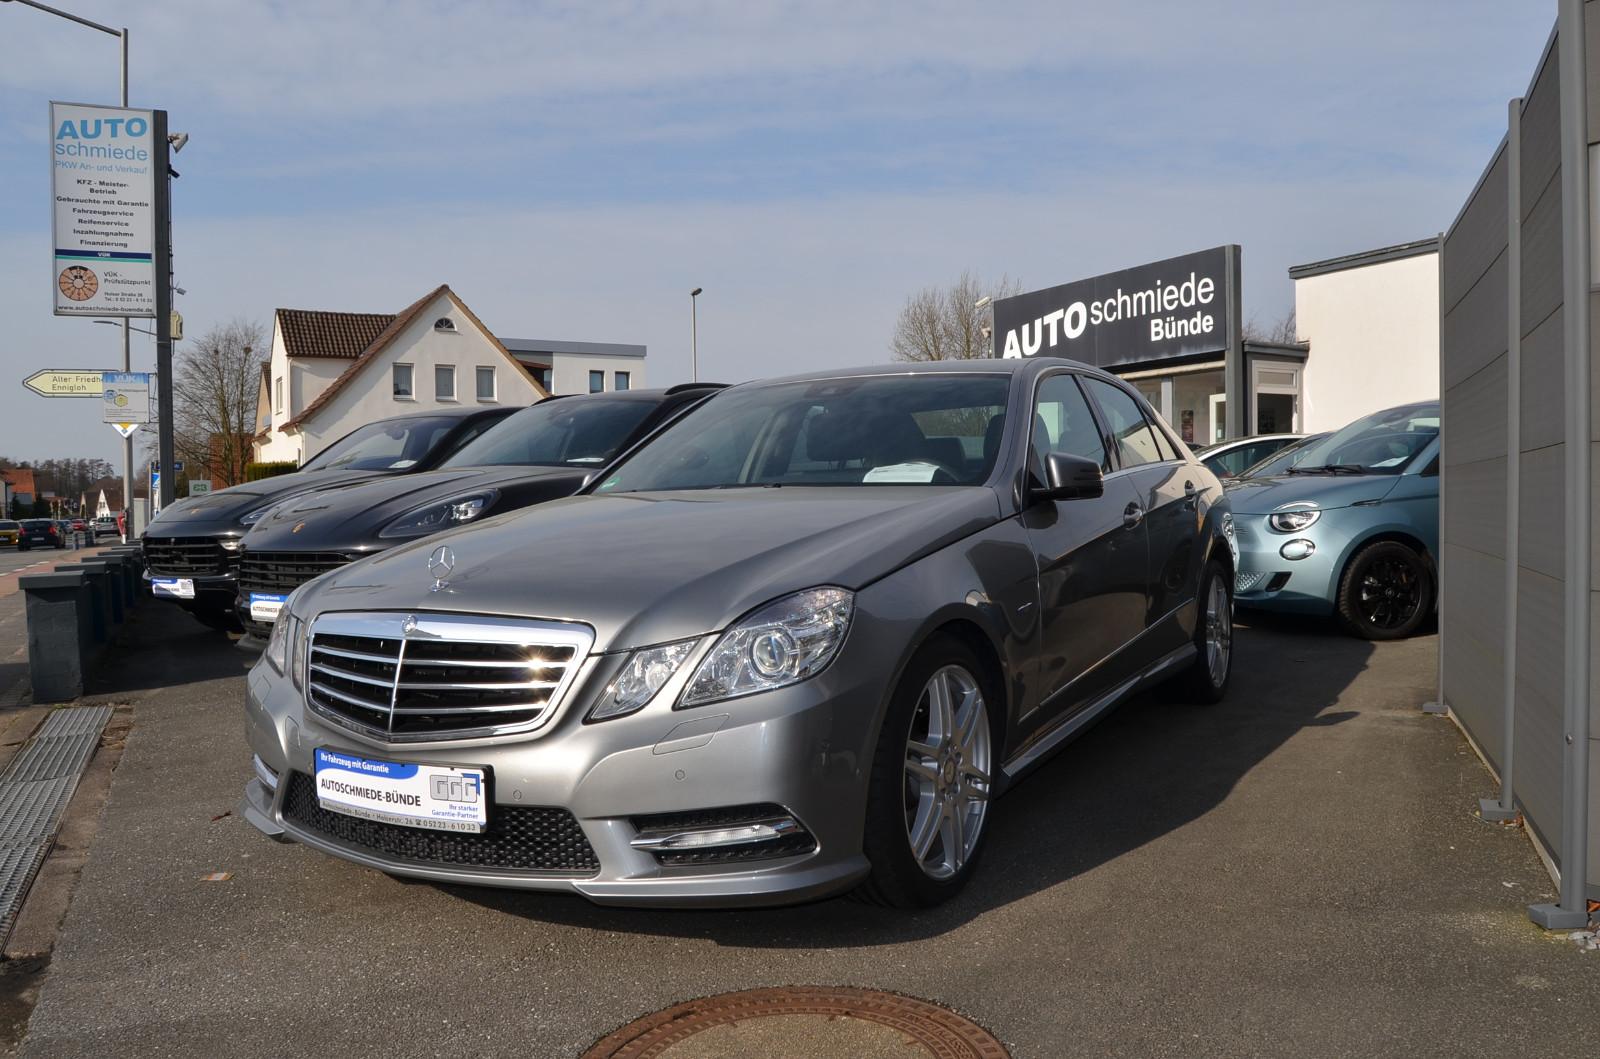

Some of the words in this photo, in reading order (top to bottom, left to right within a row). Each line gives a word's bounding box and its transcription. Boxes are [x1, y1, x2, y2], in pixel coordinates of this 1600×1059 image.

[56, 118, 147, 140] AUTO
[56, 142, 148, 161] schmiede
[56, 161, 77, 169] PKW
[80, 162, 95, 170] An-
[97, 163, 113, 172] und
[115, 165, 148, 175] Verkauf
[56, 196, 101, 204] Gebrauchte
[118, 200, 149, 208] Garantie
[73, 208, 134, 217] Fahrzeugservice
[78, 219, 130, 227] Reifenservice
[73, 229, 134, 238] Inzahlungnahme
[80, 240, 128, 249] Finanzierung
[104, 278, 151, 286] Prüfstützpunkt
[1003, 302, 1088, 360] AUTO
[1090, 272, 1215, 325] schmiede
[1151, 312, 1214, 342] Bünde
[52, 384, 87, 392] Ennigloh
[320, 753, 328, 761] Ihr
[328, 754, 352, 768] Fahrzeug
[351, 761, 361, 769] mit
[362, 762, 389, 774] Garantie
[320, 778, 421, 807] AUTOSCHMIEDE-BÜNDE
[448, 803, 458, 811] Ihr
[431, 809, 479, 819] Garantie-Partner
